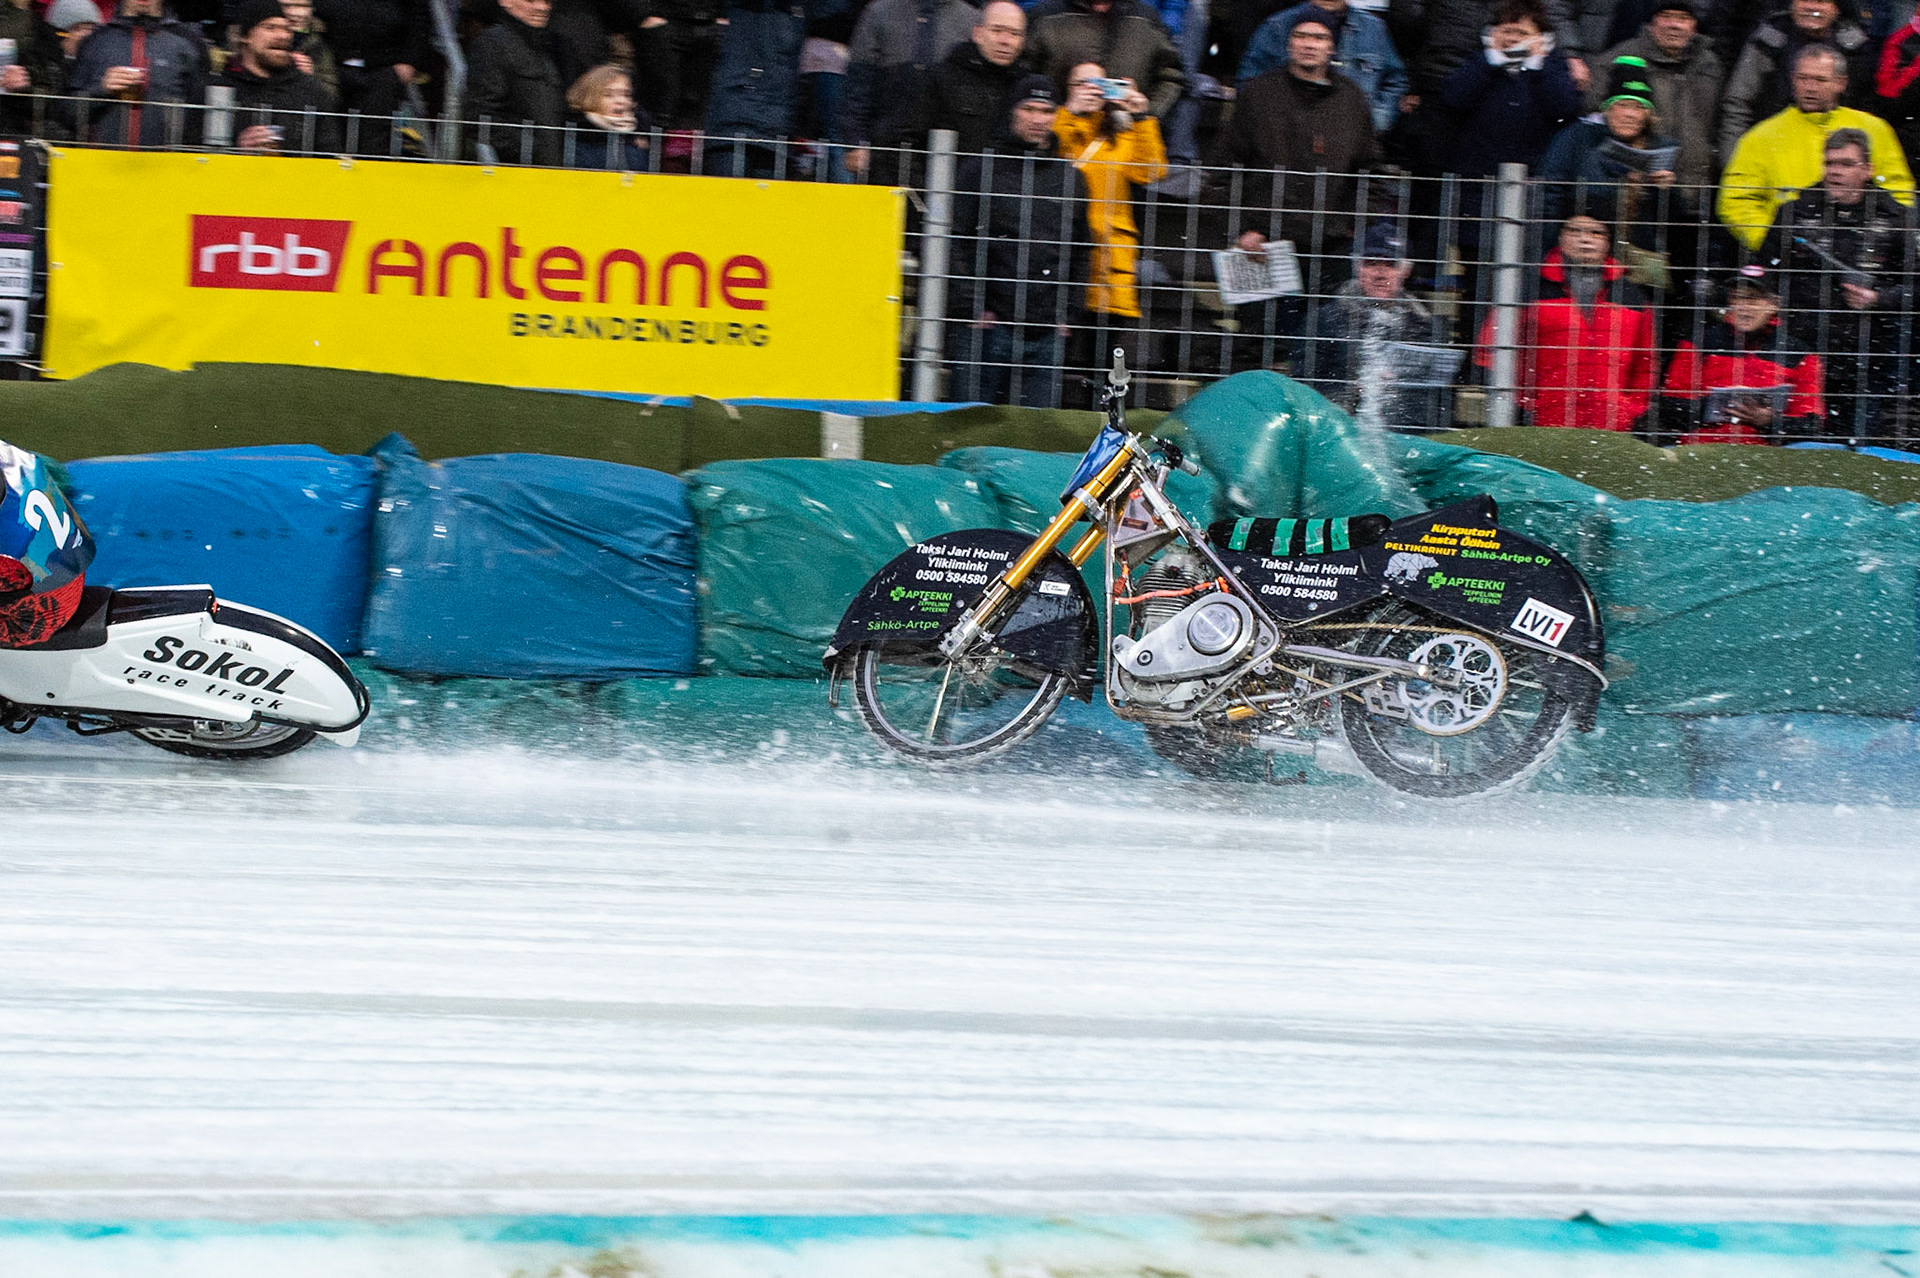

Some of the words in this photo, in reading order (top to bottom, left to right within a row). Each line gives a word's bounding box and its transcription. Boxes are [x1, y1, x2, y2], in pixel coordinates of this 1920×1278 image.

[199, 231, 330, 277] rbb
[366, 226, 770, 311] Antenne
[509, 312, 771, 347] BRANDENBURG
[24, 489, 70, 550] 2
[1431, 523, 1497, 538] Kirpputori
[1419, 533, 1458, 546] Aasta
[916, 543, 945, 556] Taksi
[947, 546, 970, 558] Jari
[972, 548, 1009, 561] Holmi
[1384, 542, 1458, 556] PELTIKARHUT
[927, 557, 988, 572] Ylikiiminki
[1460, 549, 1532, 564] Sähkö-Artpe
[1534, 555, 1552, 567] Oy
[1260, 558, 1293, 571] Taksi
[1294, 561, 1320, 573] Jari
[1321, 563, 1358, 576] Holmi
[915, 569, 943, 583] 0500
[947, 572, 988, 585] 584580
[1273, 573, 1338, 588] Ylikiiminki
[1447, 577, 1506, 592] APTEEKKI
[905, 590, 953, 601] APTEEKKI
[1260, 584, 1291, 597] 0500
[1293, 588, 1338, 601] 584580
[867, 618, 940, 632] Sähkö-Artpe
[1518, 608, 1565, 641] LVI1
[123, 666, 188, 688] race
[204, 683, 284, 710] track
